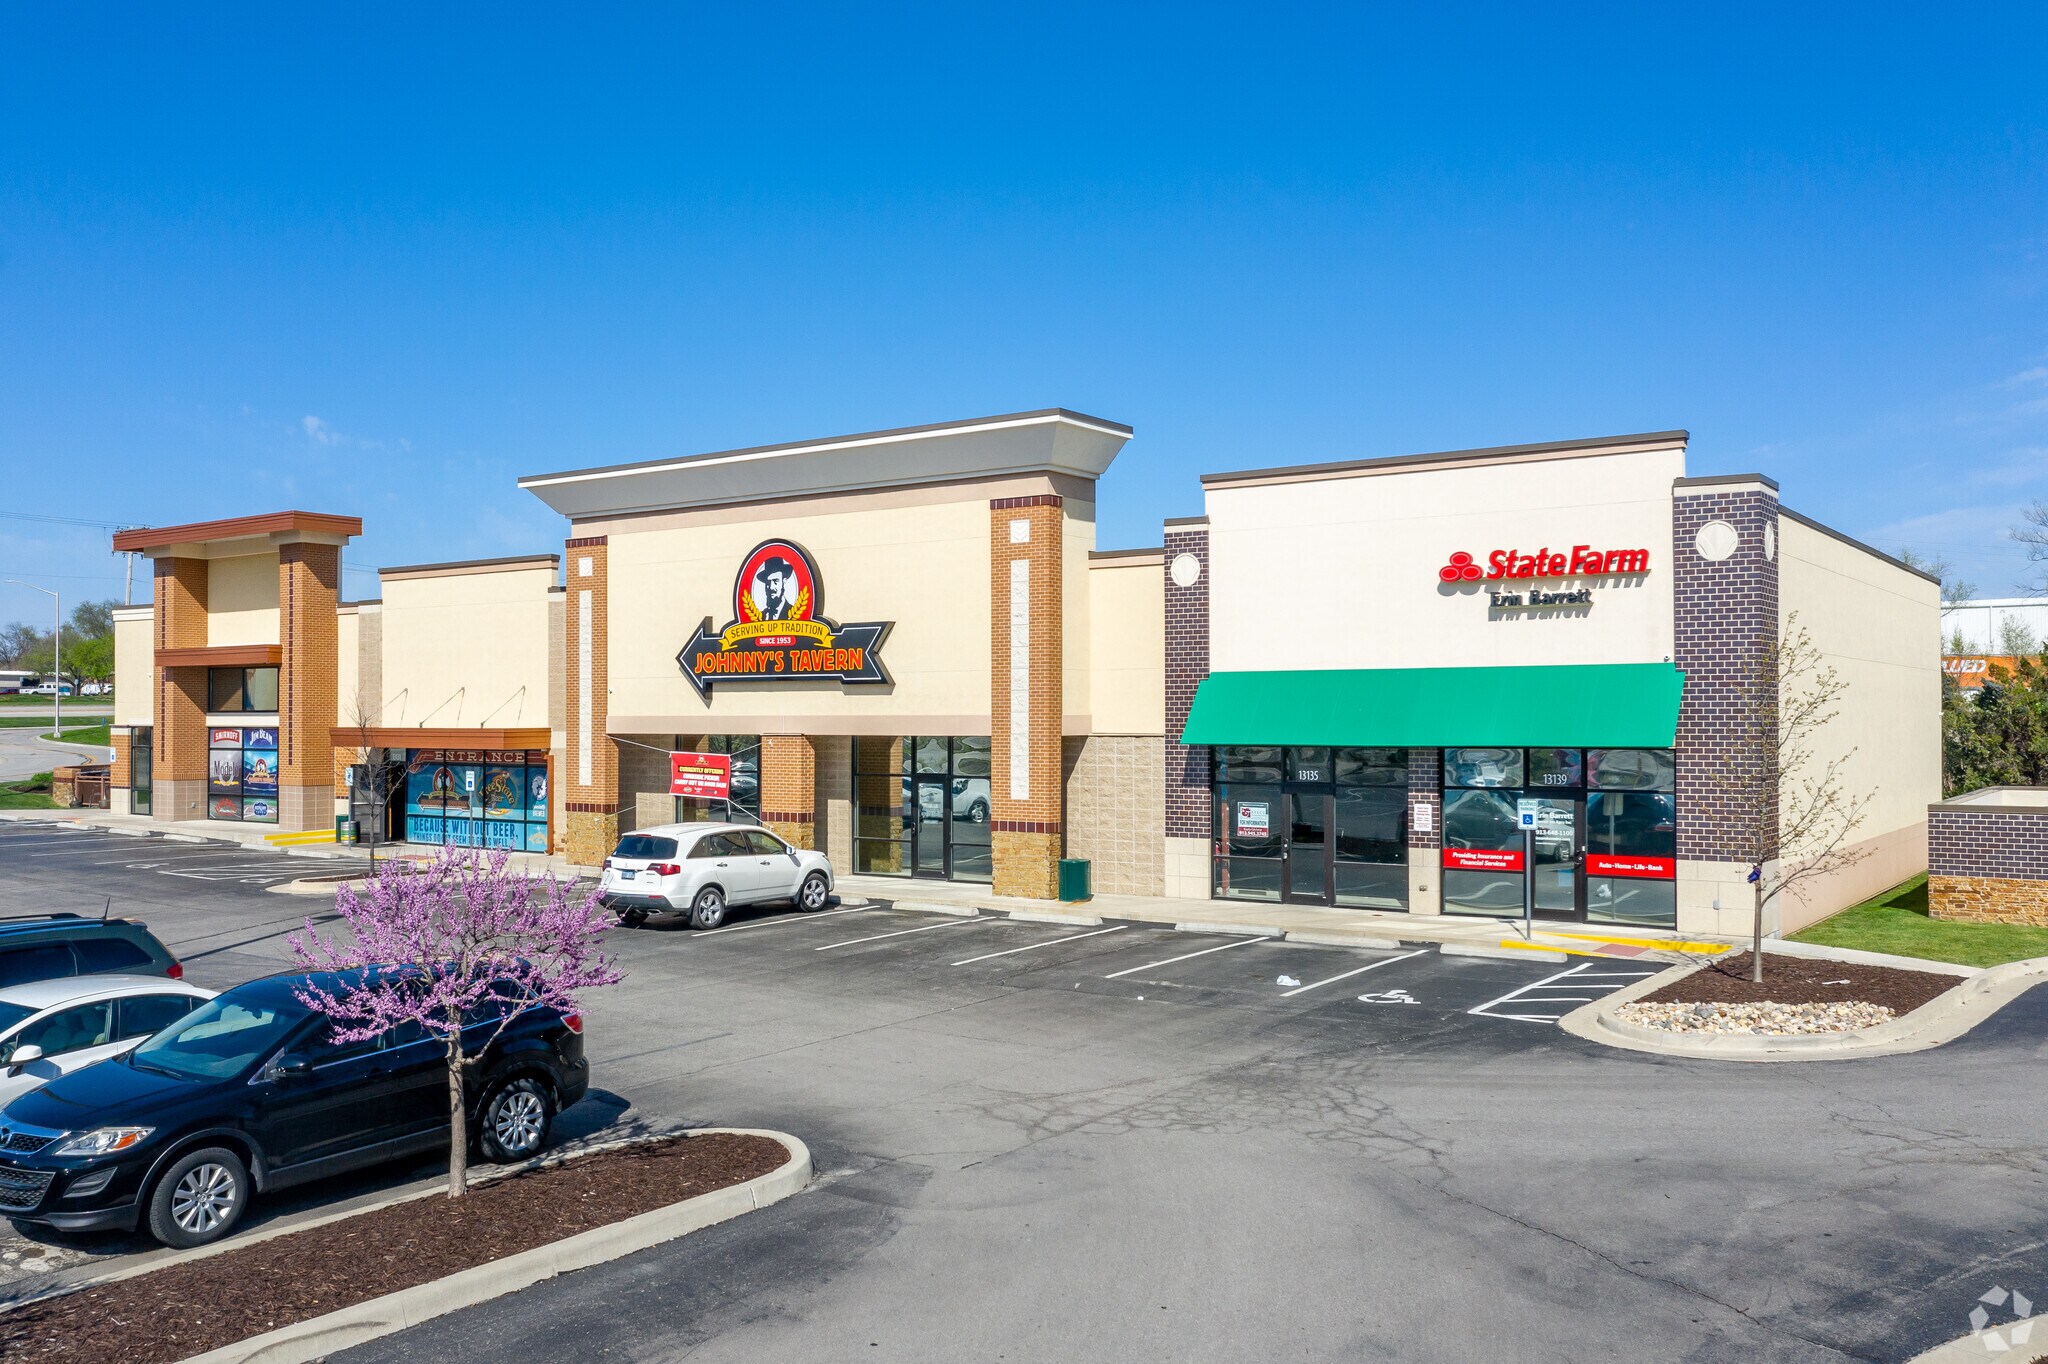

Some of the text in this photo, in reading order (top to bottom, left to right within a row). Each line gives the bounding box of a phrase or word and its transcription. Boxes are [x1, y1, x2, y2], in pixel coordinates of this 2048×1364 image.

[1490, 589, 1592, 607] Erin Barrett
[730, 622, 823, 638] SERVING UP TRADITION
[759, 637, 775, 645] SINCE
[695, 648, 863, 674] JOHNNY'S TAVERN
[1941, 659, 1987, 673] LLIED
[215, 731, 239, 740] SMIRNOFF
[249, 729, 273, 746] JIM BEAM
[434, 751, 525, 762] ENTRANCE
[1298, 770, 1319, 780] 13135
[1543, 774, 1567, 785] 13139
[413, 832, 432, 841] THINGS
[493, 823, 518, 839] BEER,
[1477, 852, 1502, 860] Insurance
